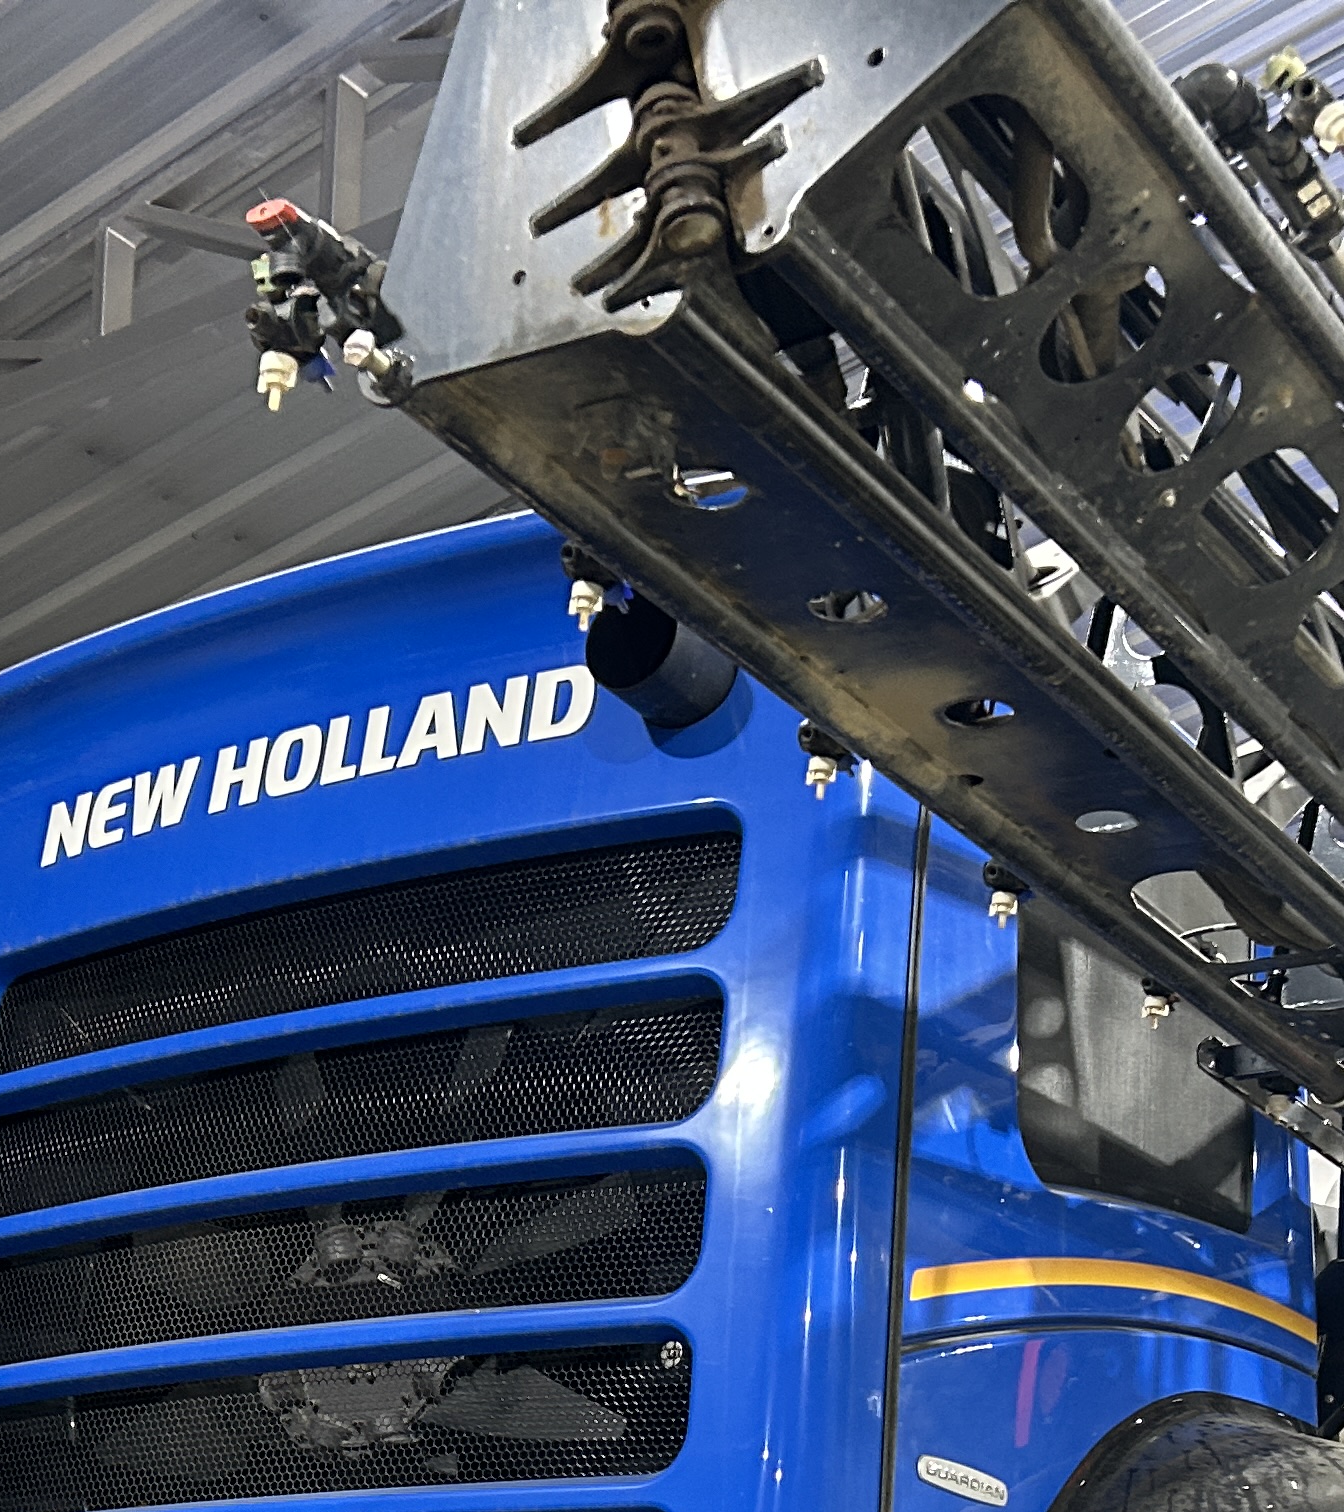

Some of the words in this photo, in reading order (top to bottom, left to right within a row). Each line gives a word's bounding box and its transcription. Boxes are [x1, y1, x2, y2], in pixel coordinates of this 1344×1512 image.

[40, 756, 200, 868] NEW
[208, 664, 596, 814] HOLLAND
[926, 1460, 1005, 1501] GUARDIAN
